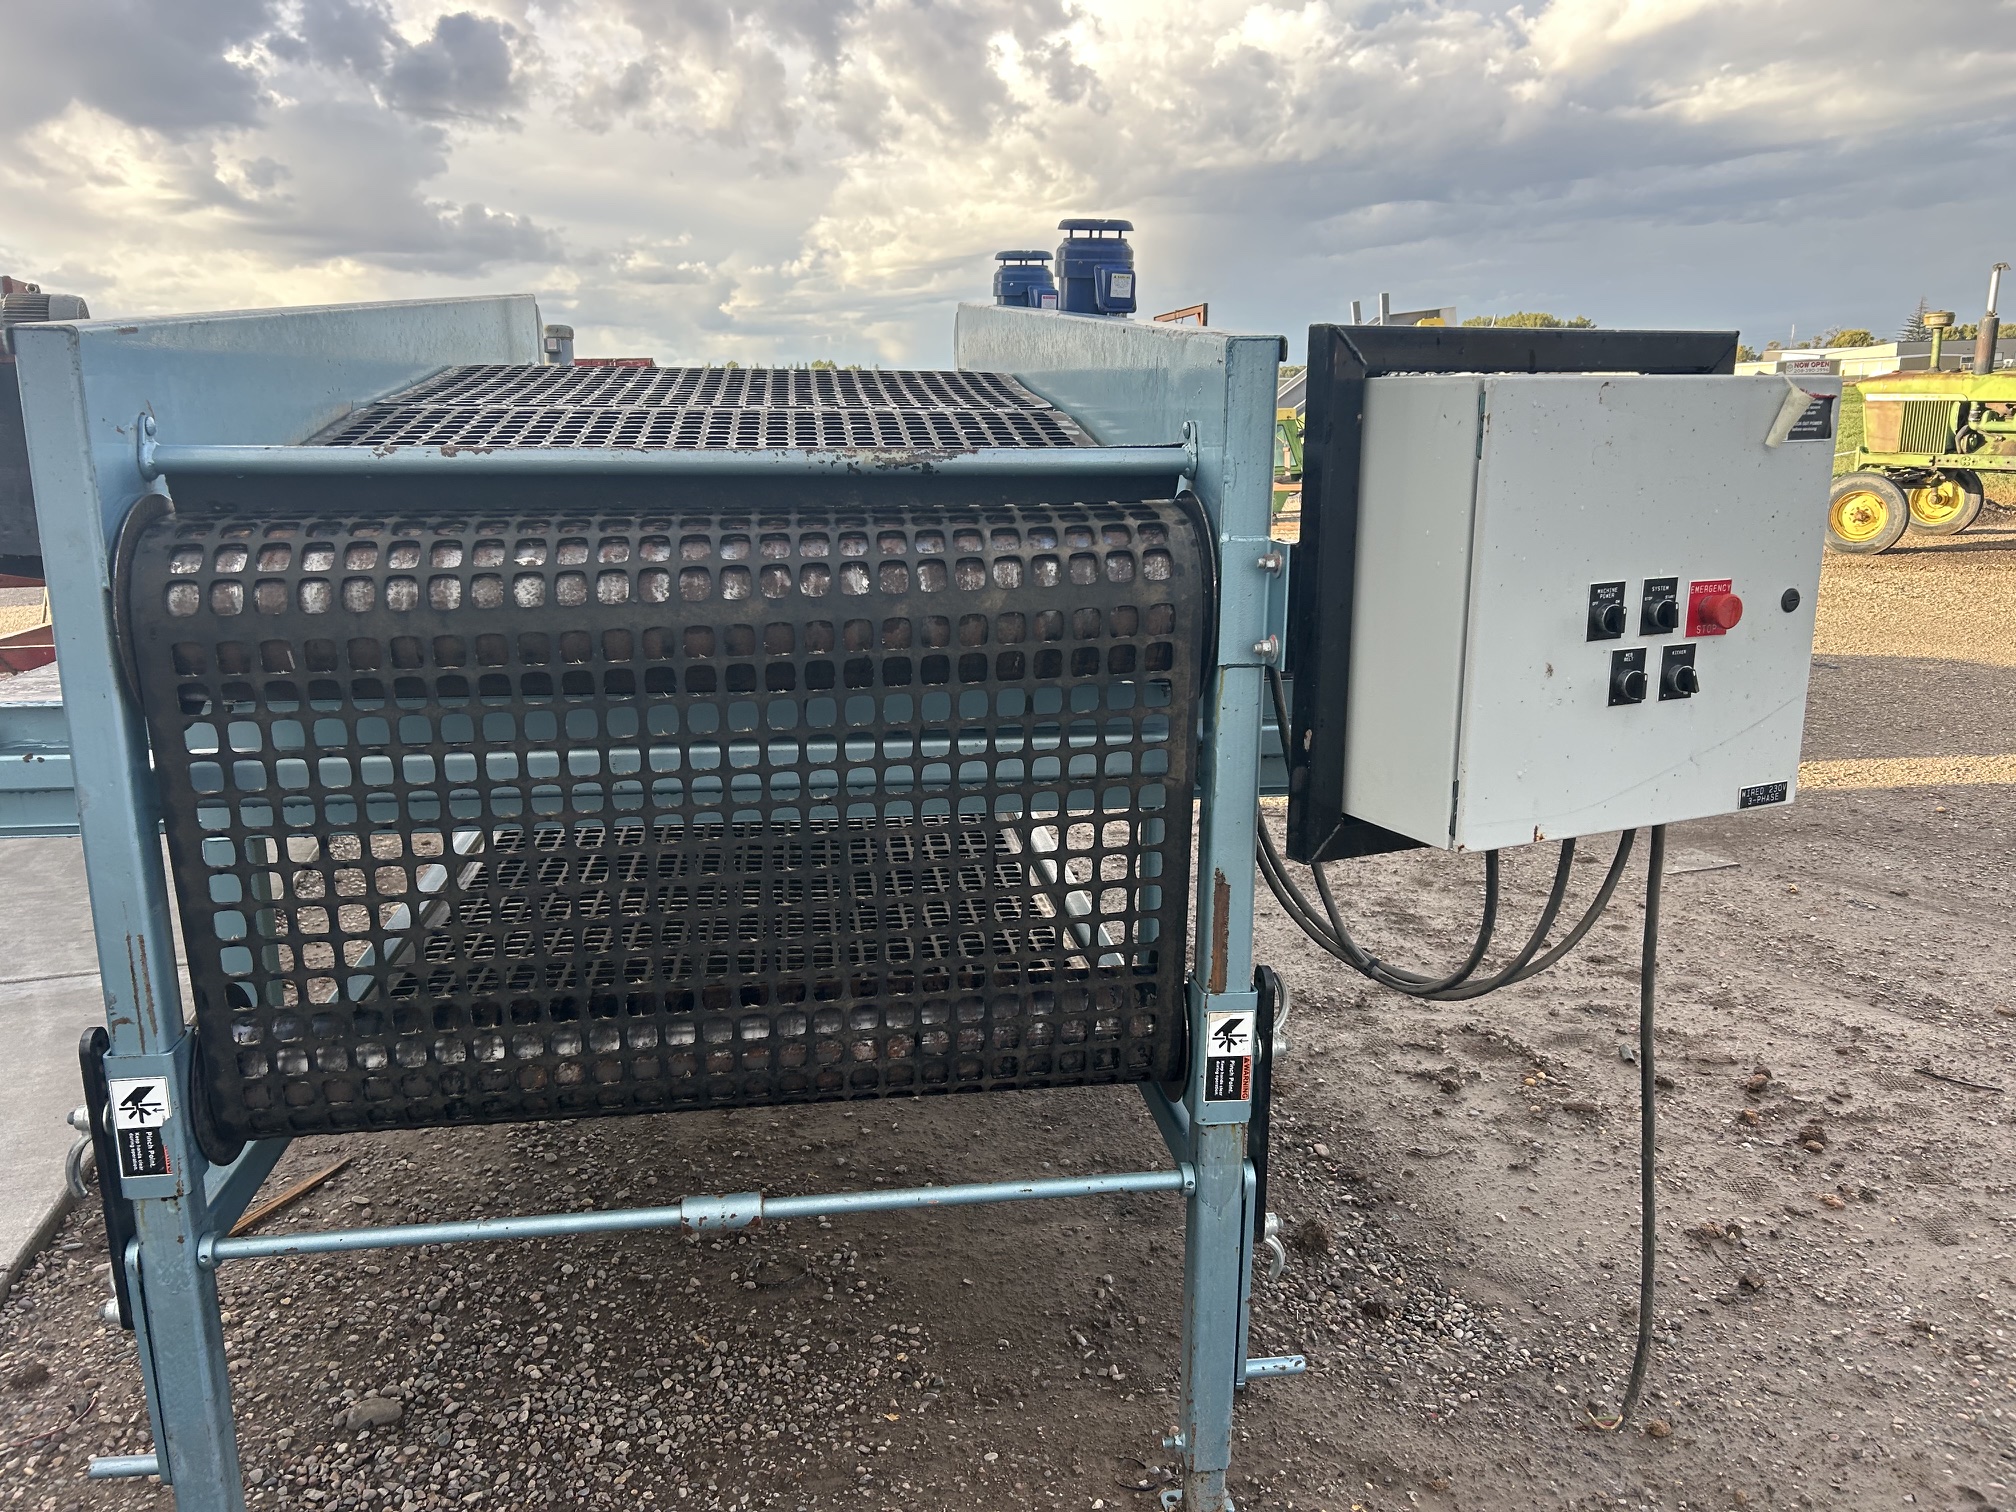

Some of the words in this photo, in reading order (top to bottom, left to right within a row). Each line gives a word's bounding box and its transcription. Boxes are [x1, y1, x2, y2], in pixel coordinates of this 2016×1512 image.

[1691, 584, 1731, 594] EMERGENCY
[1696, 624, 1717, 634] STOP
[1742, 787, 1764, 797] WIRED
[1769, 783, 1787, 793] 230V
[1748, 793, 1779, 805] 3-PHASE
